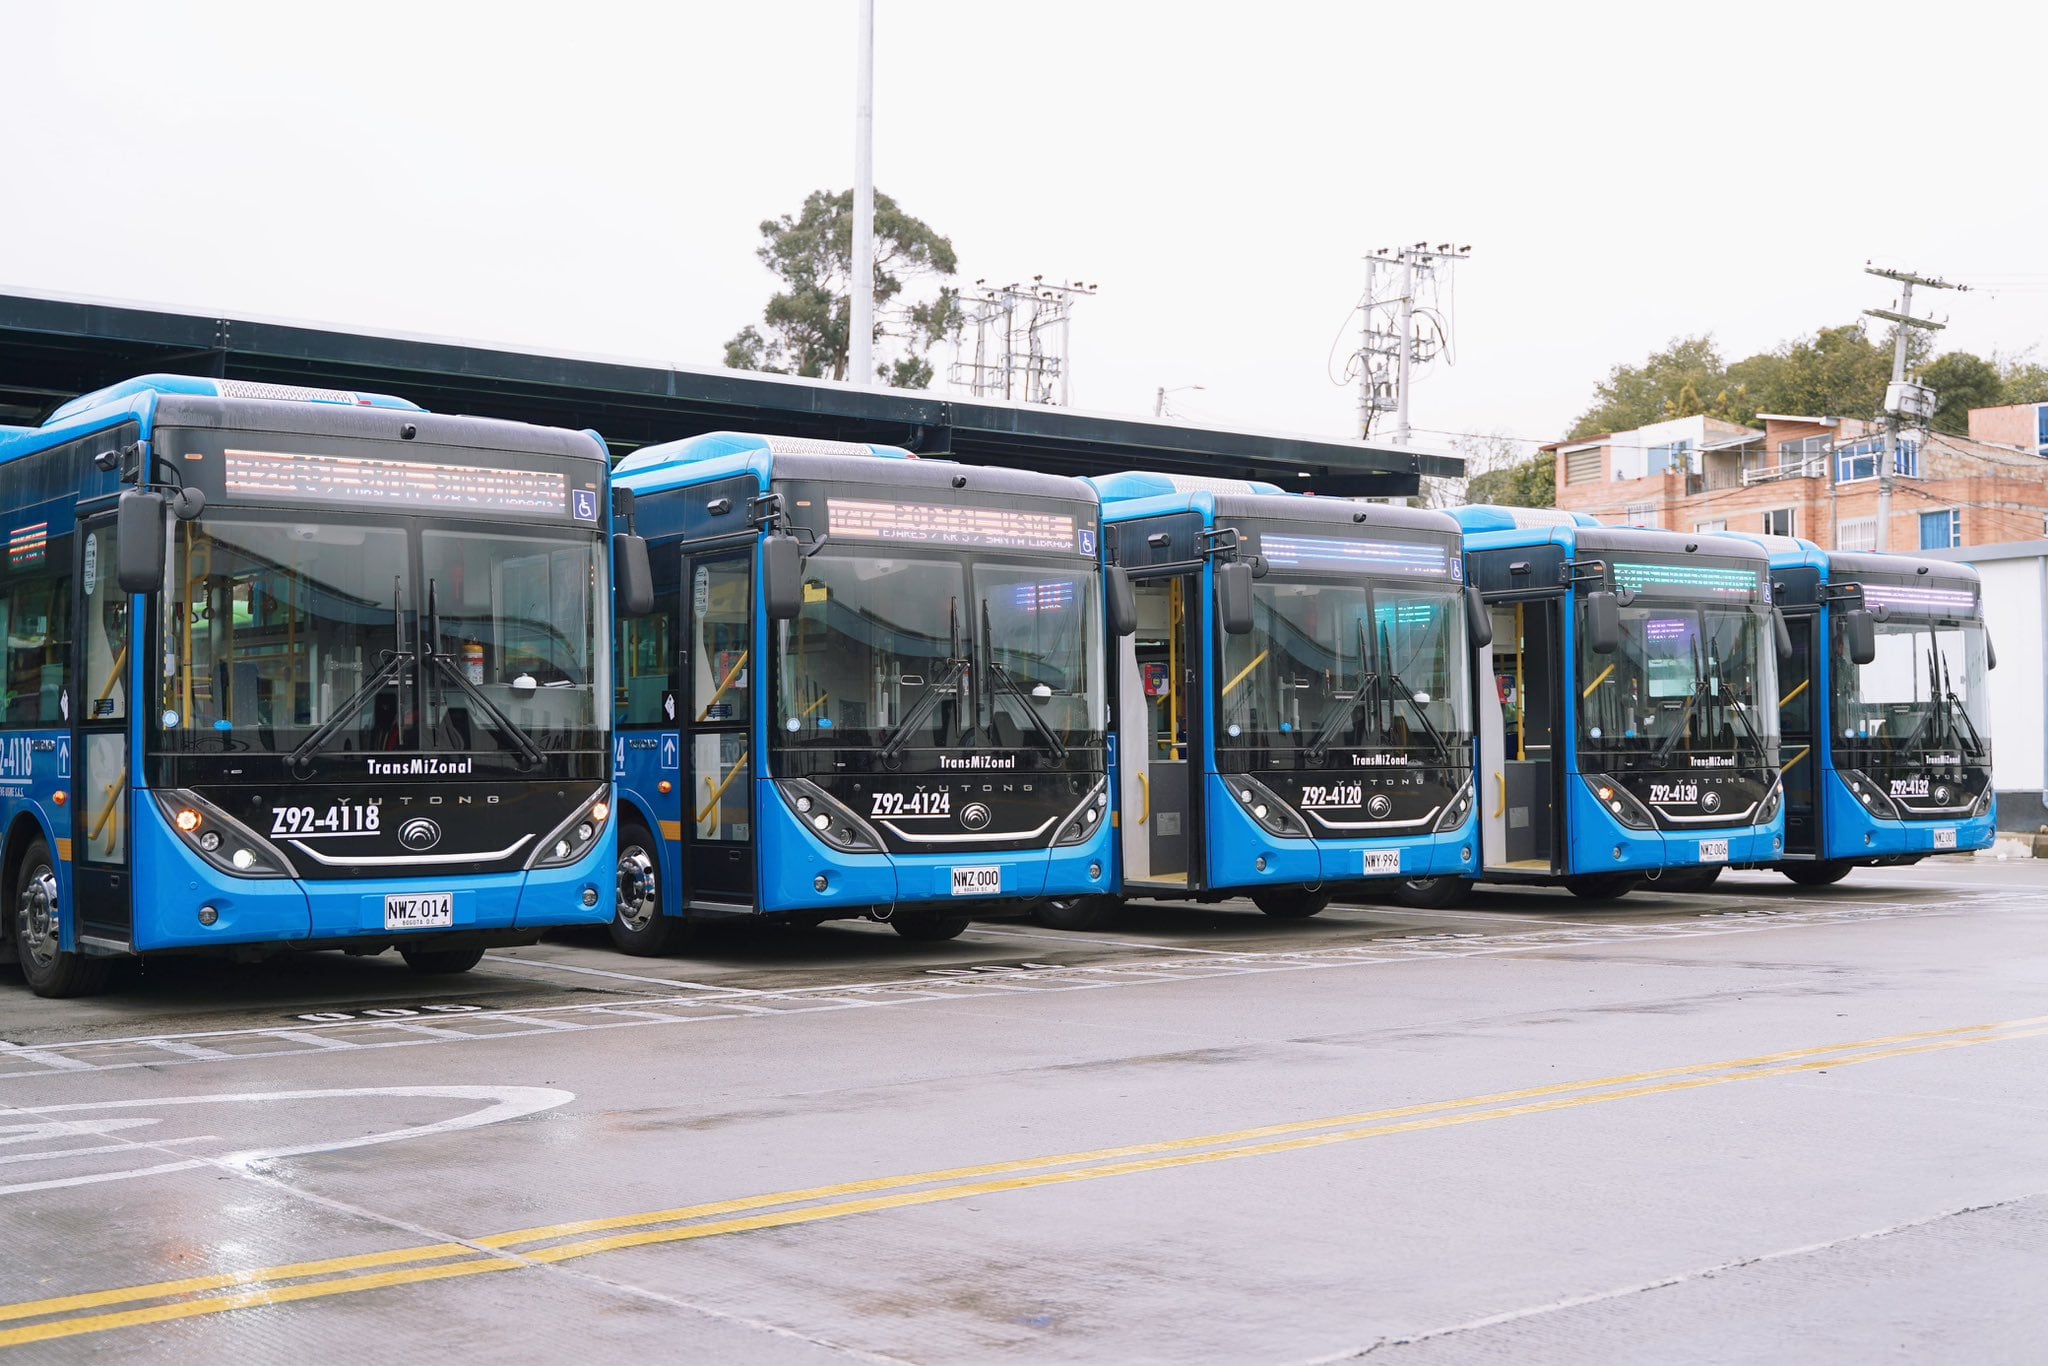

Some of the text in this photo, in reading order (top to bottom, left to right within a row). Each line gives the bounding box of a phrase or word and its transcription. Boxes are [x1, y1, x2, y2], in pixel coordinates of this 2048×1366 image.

[368, 758, 471, 774] TransMiZonal
[940, 755, 1015, 769] TransMiZonal
[1352, 754, 1408, 766] TransMiZonal
[1690, 756, 1735, 767] TransMiZonal
[916, 784, 1033, 793] YUTONG
[1336, 779, 1424, 787] YUTONG
[1890, 780, 1929, 795] Z92-4132
[338, 795, 500, 806] YUTONG
[1301, 786, 1361, 805] Z92-4120
[1649, 785, 1697, 801] Z92-4130
[871, 793, 950, 815] Z92-4124
[271, 805, 380, 834] Z92-4118
[1383, 854, 1398, 867] 996
[954, 870, 998, 887] NWZ 000
[388, 899, 449, 919] NWZ 014
